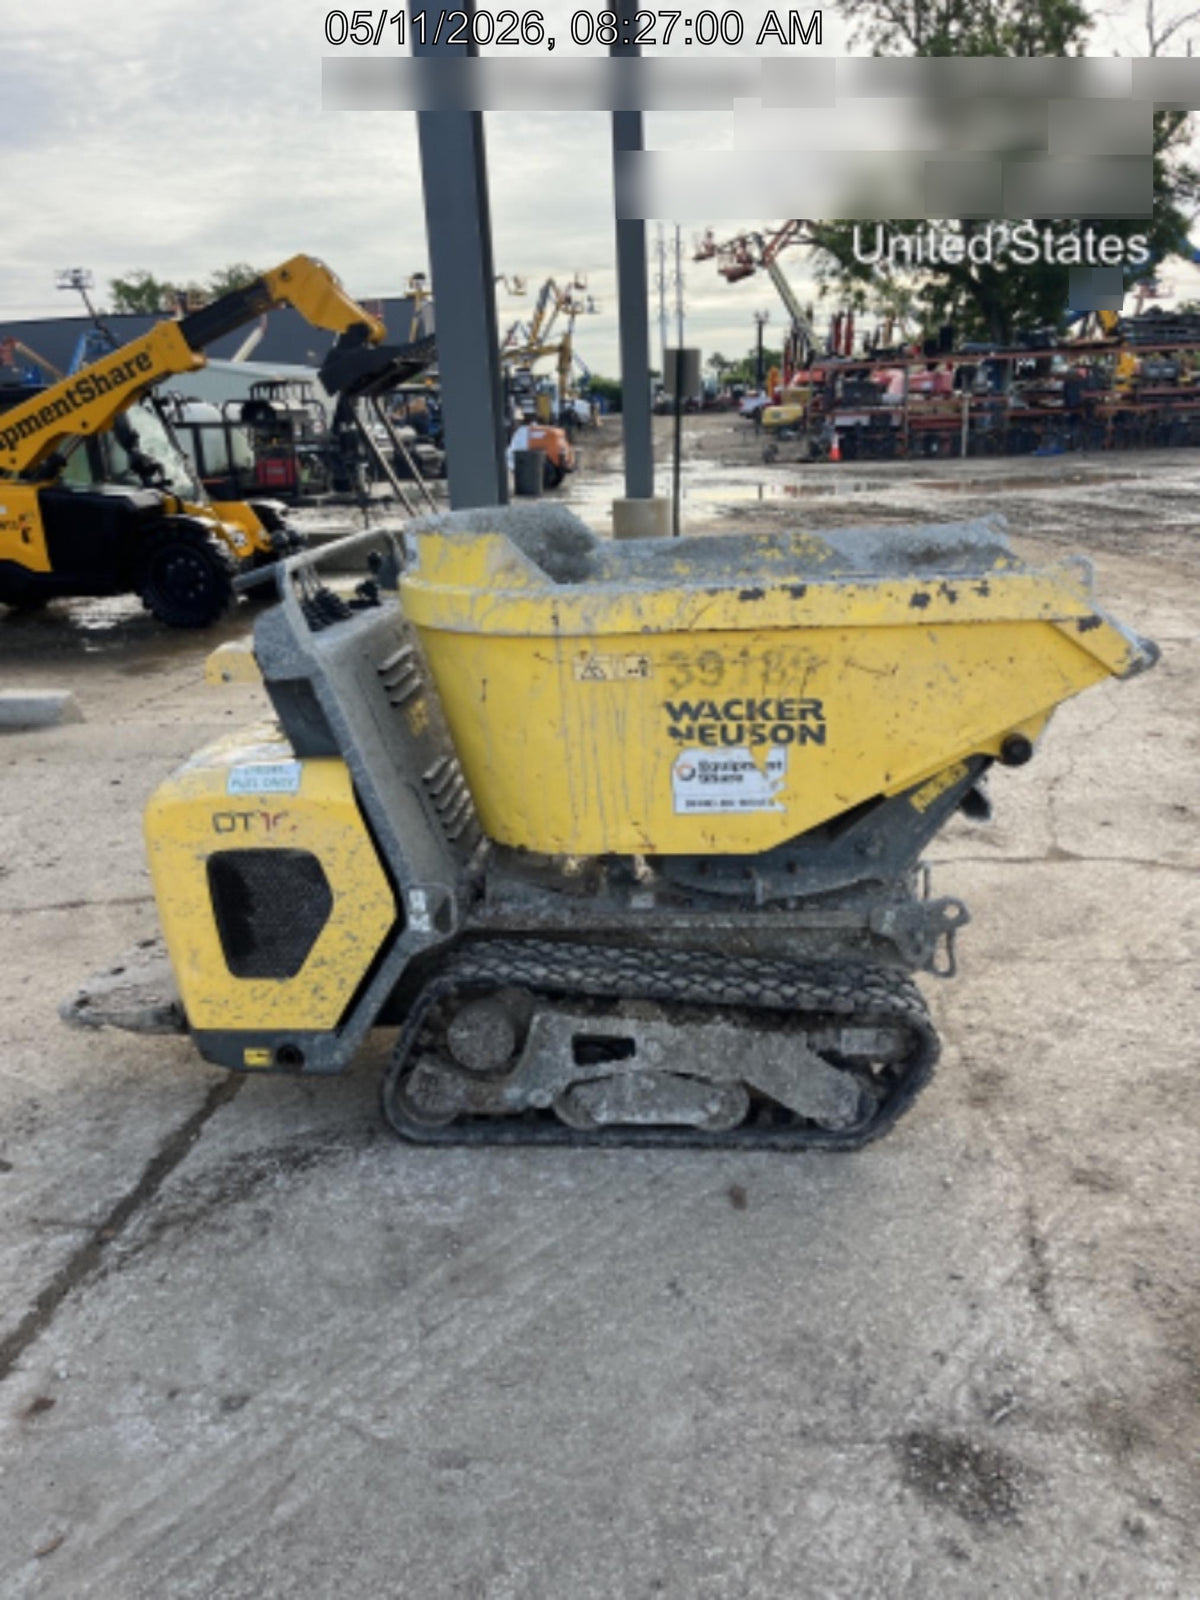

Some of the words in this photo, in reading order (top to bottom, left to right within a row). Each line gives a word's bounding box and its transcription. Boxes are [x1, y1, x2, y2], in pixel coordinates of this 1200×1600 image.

[0, 350, 153, 452] pmentShare
[663, 698, 827, 723] WACKER
[666, 723, 827, 746] NEUSON
[698, 760, 783, 773] Equipmnt
